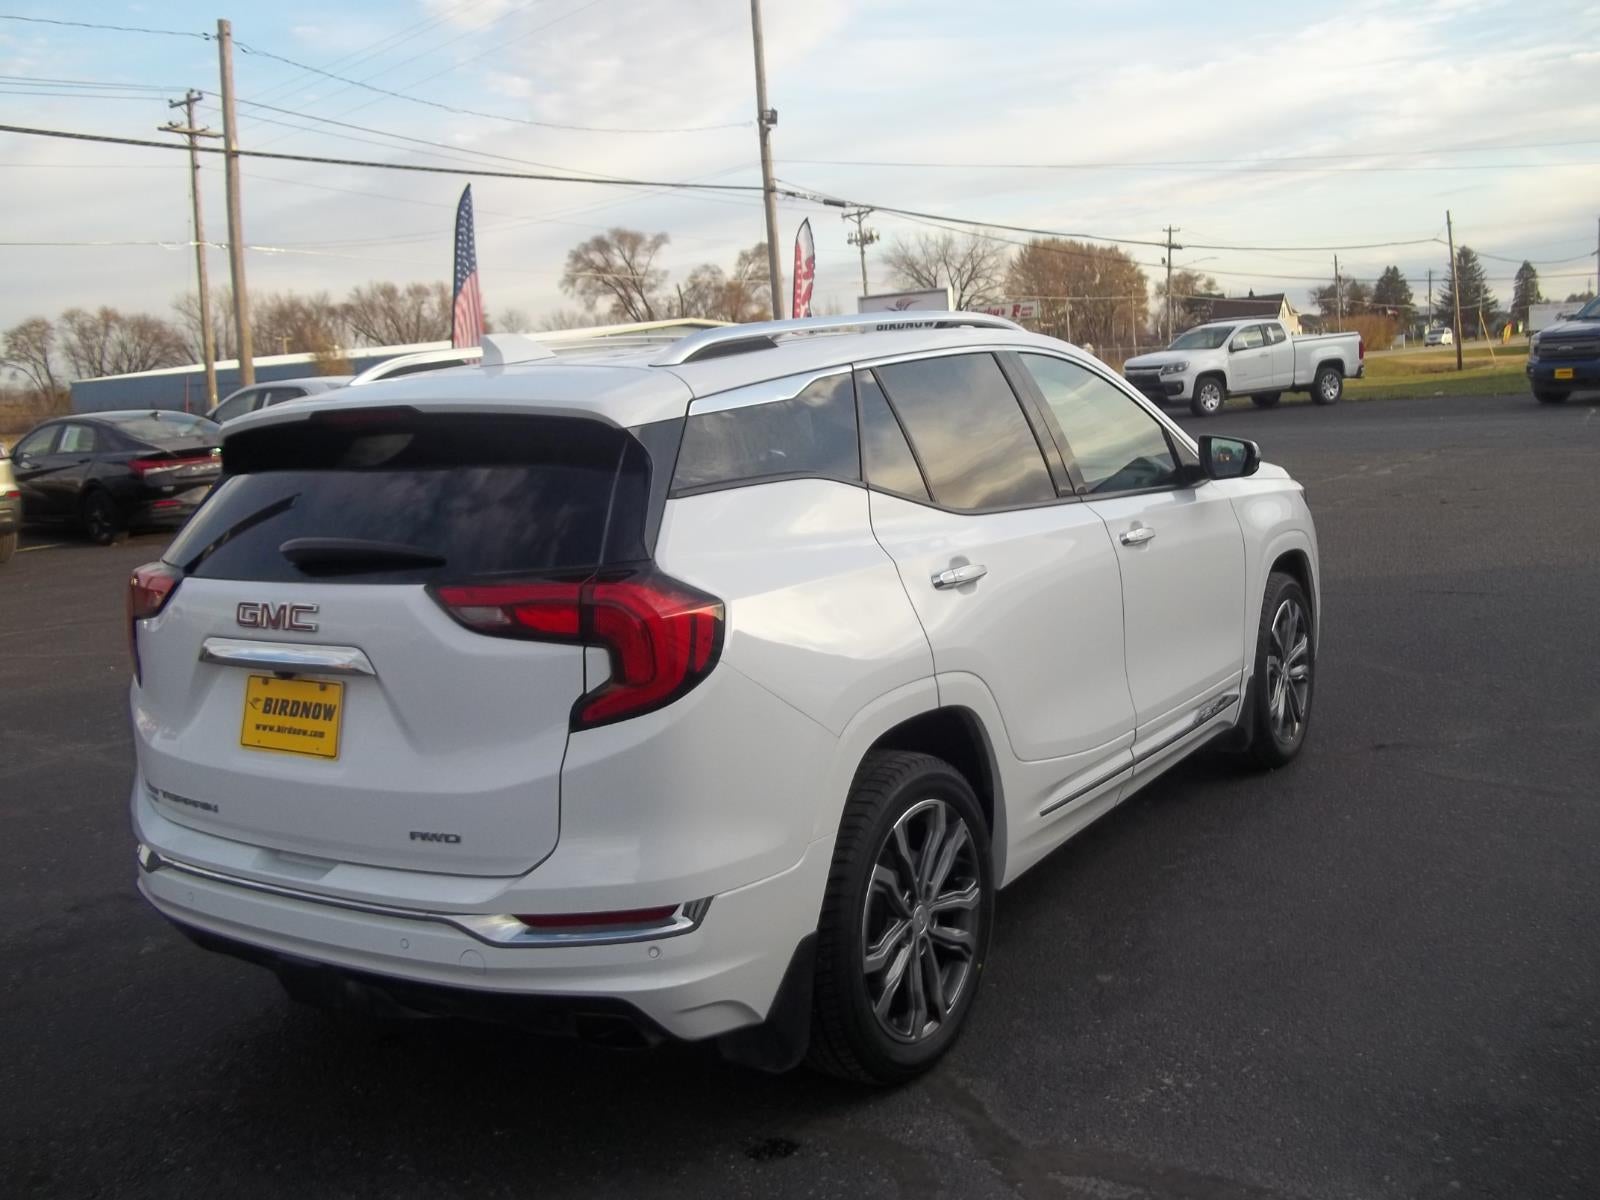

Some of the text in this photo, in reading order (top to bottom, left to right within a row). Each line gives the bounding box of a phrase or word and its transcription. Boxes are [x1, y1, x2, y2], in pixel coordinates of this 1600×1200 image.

[236, 602, 319, 632] GMC
[262, 697, 337, 722] BIRDNOW
[255, 723, 326, 738] www.birdnow.com
[409, 831, 461, 843] AWD
